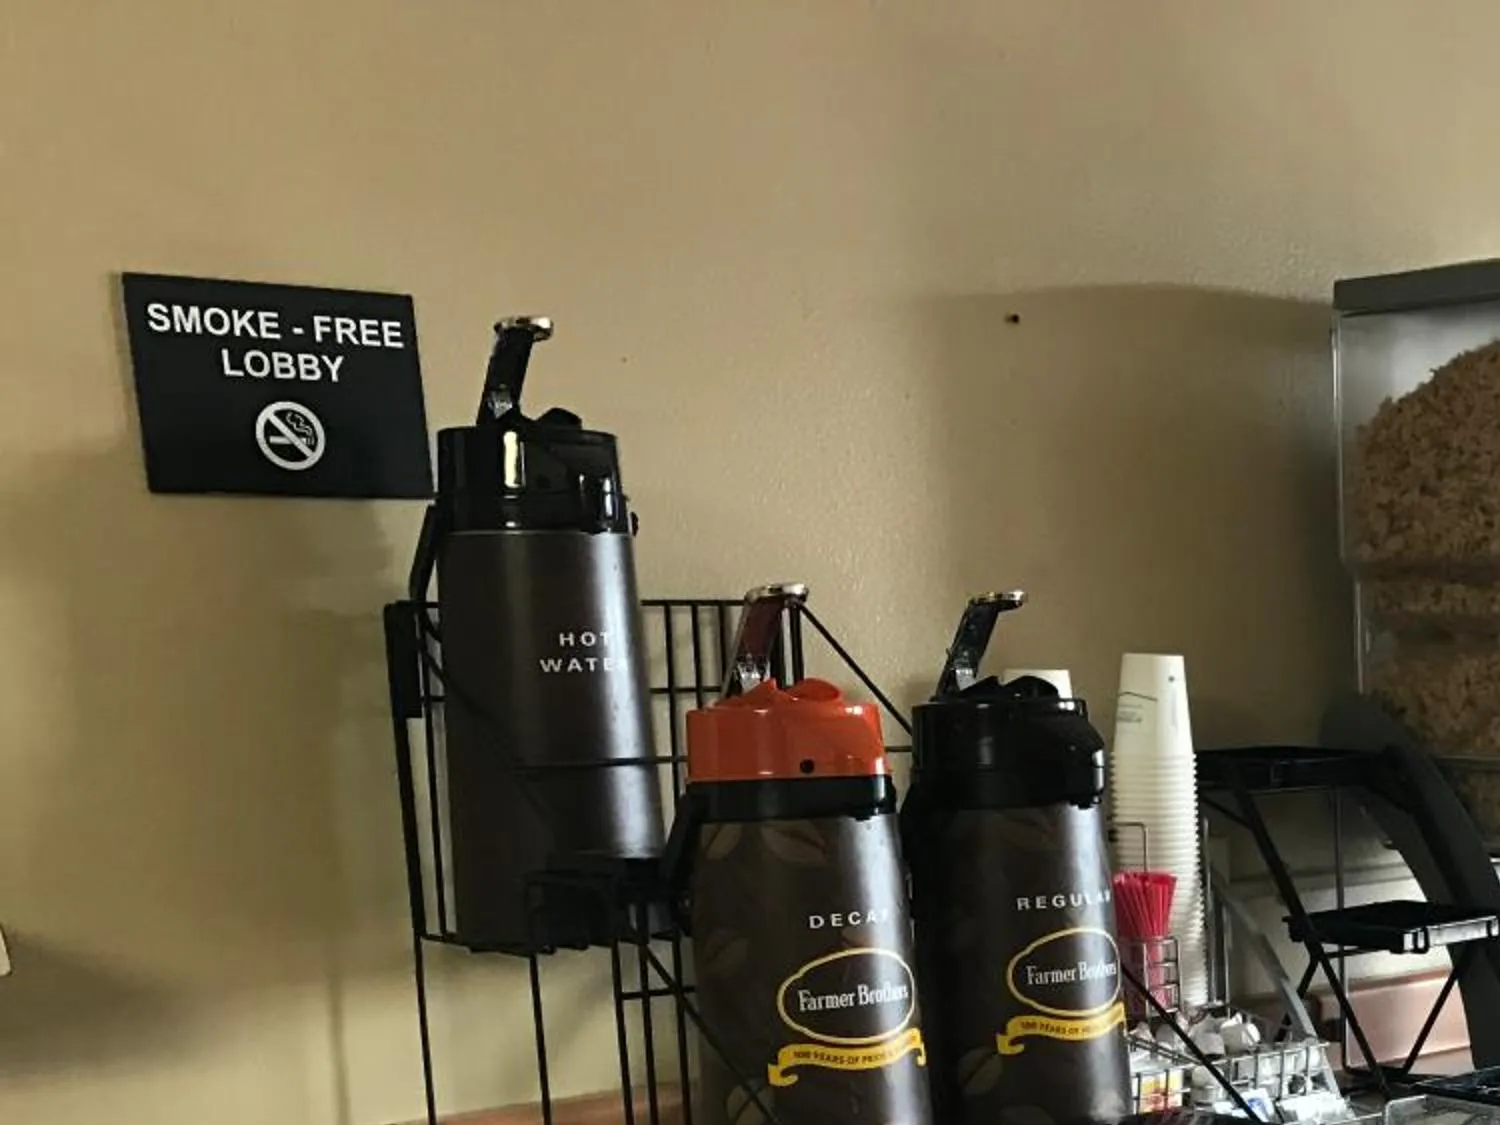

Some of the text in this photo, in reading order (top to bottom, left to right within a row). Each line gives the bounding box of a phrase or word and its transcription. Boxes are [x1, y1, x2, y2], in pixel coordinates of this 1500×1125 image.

[147, 303, 281, 340] SMOKE
[313, 315, 405, 349] FREE
[221, 348, 344, 382] LOBBY
[559, 631, 611, 647] HOT
[539, 656, 622, 673] WATE
[1026, 965, 1076, 986] Farmer
[798, 988, 855, 1013] Farmer
